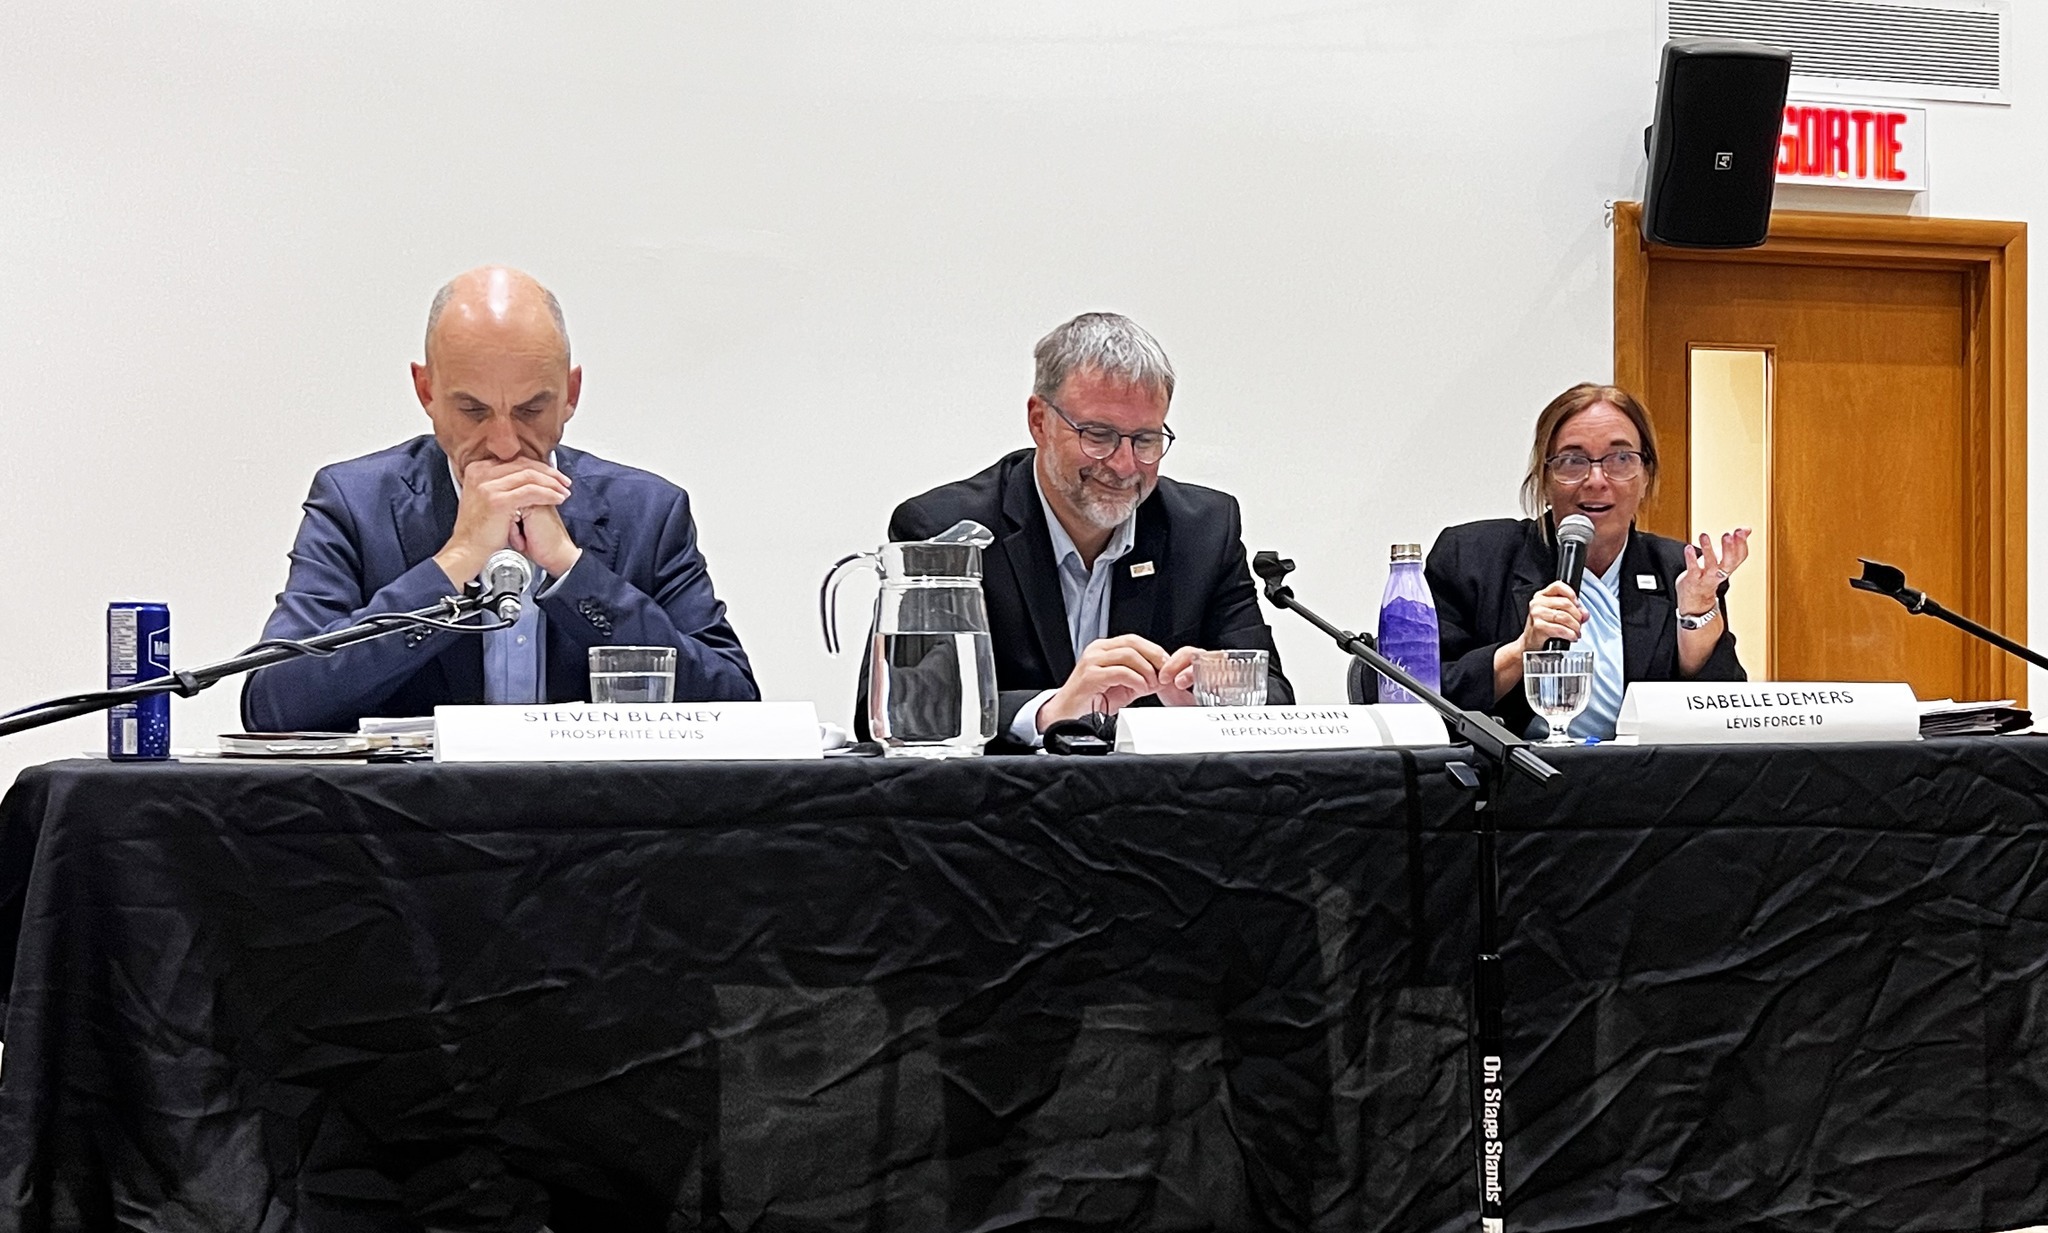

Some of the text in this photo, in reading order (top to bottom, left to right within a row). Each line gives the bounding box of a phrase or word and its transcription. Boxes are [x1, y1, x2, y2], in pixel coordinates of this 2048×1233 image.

[1775, 105, 1907, 181] SORTIE
[1686, 690, 1854, 710] ISABELLE DEMERS
[524, 711, 722, 722] STEVEN BLANEY
[1206, 711, 1349, 722] SERGE BONIN
[1764, 715, 1806, 728] FORCE
[1809, 714, 1823, 726] 10
[1221, 726, 1308, 737] REPENSONS
[1483, 1055, 1502, 1085] On
[1482, 1088, 1502, 1139] Stage
[1485, 1141, 1503, 1202] Stands
